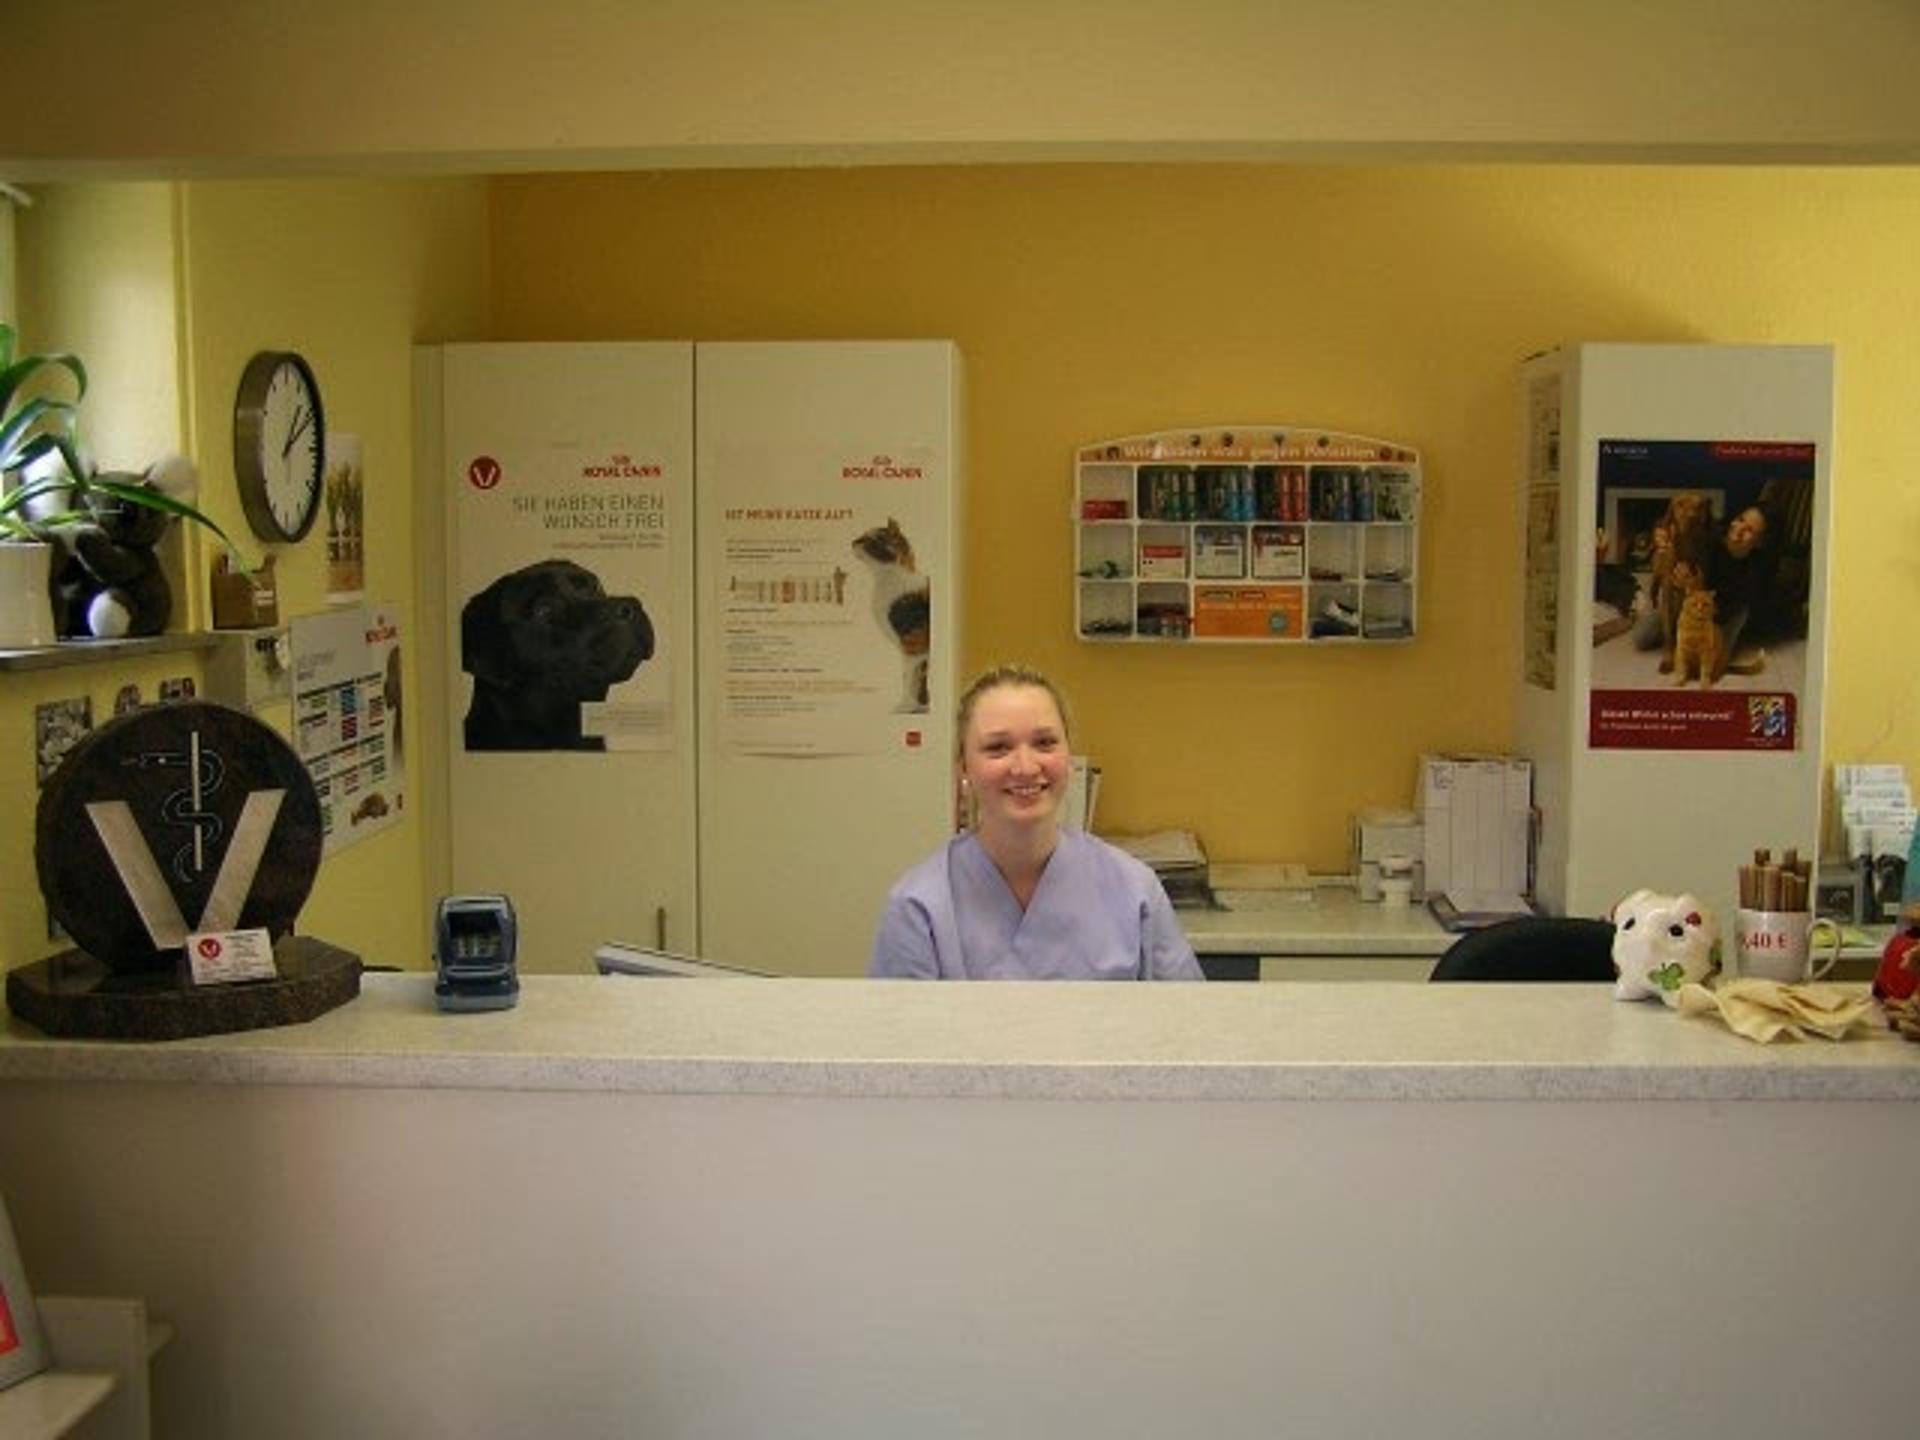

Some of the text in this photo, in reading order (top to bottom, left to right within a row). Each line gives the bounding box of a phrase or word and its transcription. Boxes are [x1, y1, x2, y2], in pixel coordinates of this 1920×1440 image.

[583, 465, 662, 478] ROYAL CANIN
[842, 466, 922, 479] ROYAL CANIN
[512, 495, 665, 512] SIE HABEN EINEN
[543, 512, 665, 529] WUNSCH FREI
[1741, 931, 1771, 950] ,40
